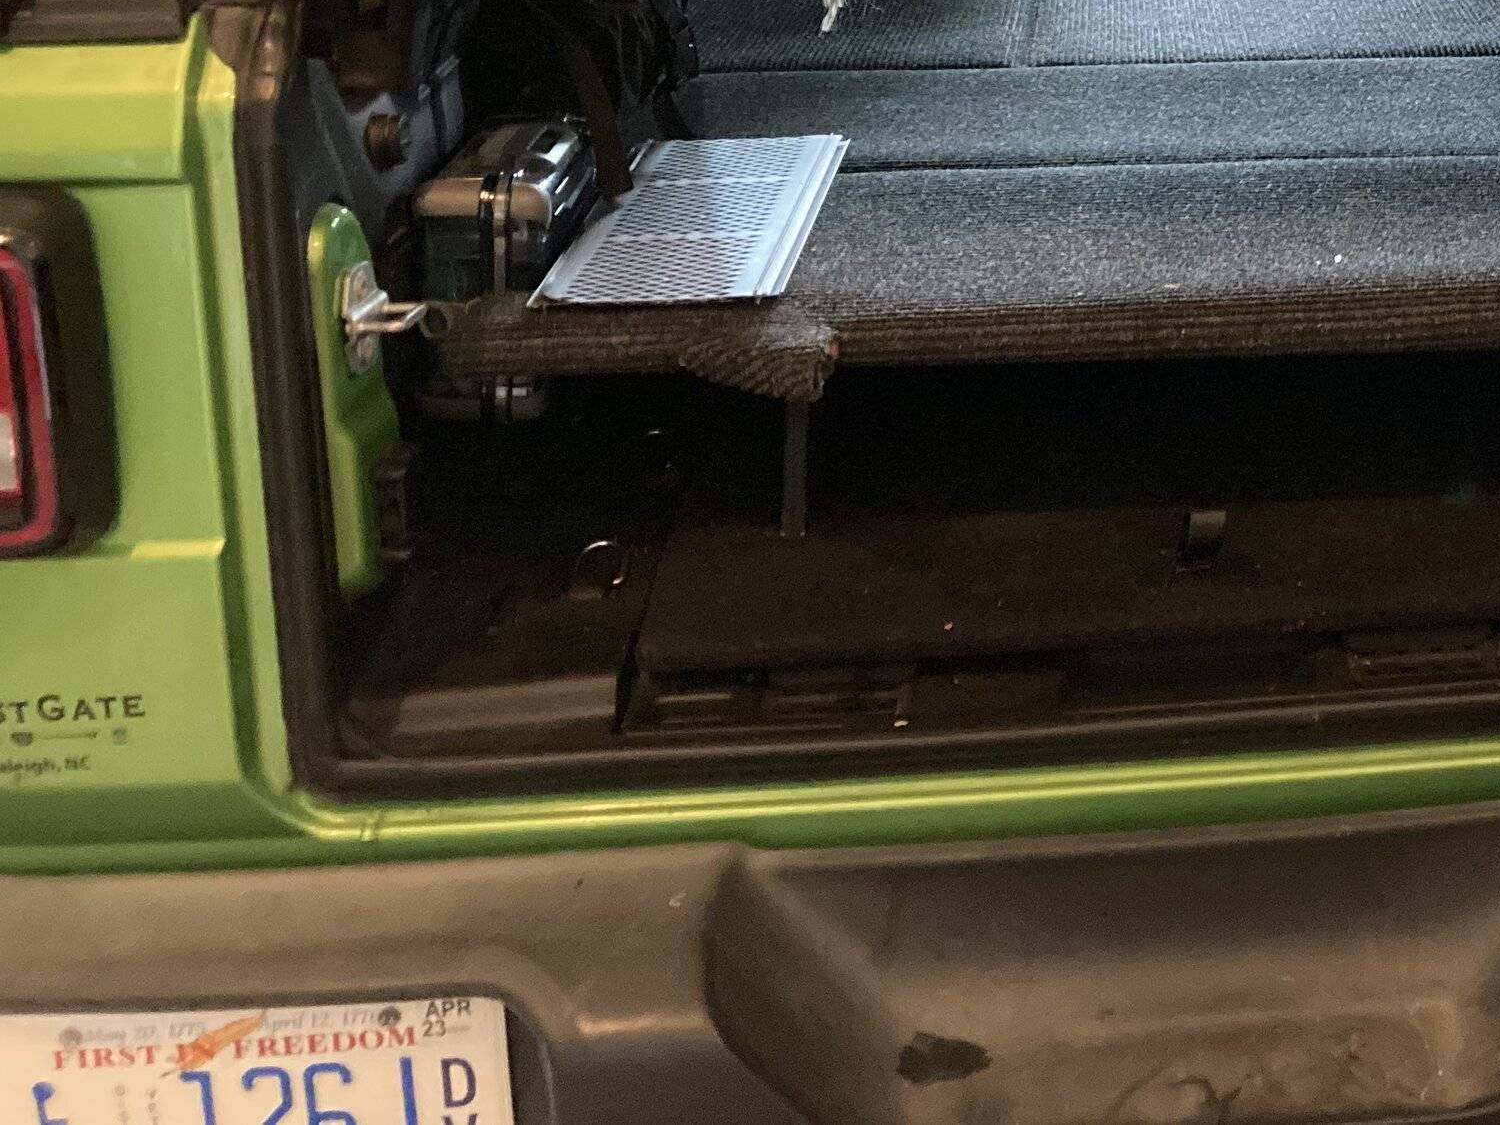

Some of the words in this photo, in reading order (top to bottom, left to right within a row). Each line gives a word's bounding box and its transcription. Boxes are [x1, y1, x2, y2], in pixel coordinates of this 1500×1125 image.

[425, 999, 472, 1019] APR
[422, 1020, 447, 1038] 23
[54, 1045, 161, 1070] FIRST
[232, 1025, 417, 1059] FREEDOM
